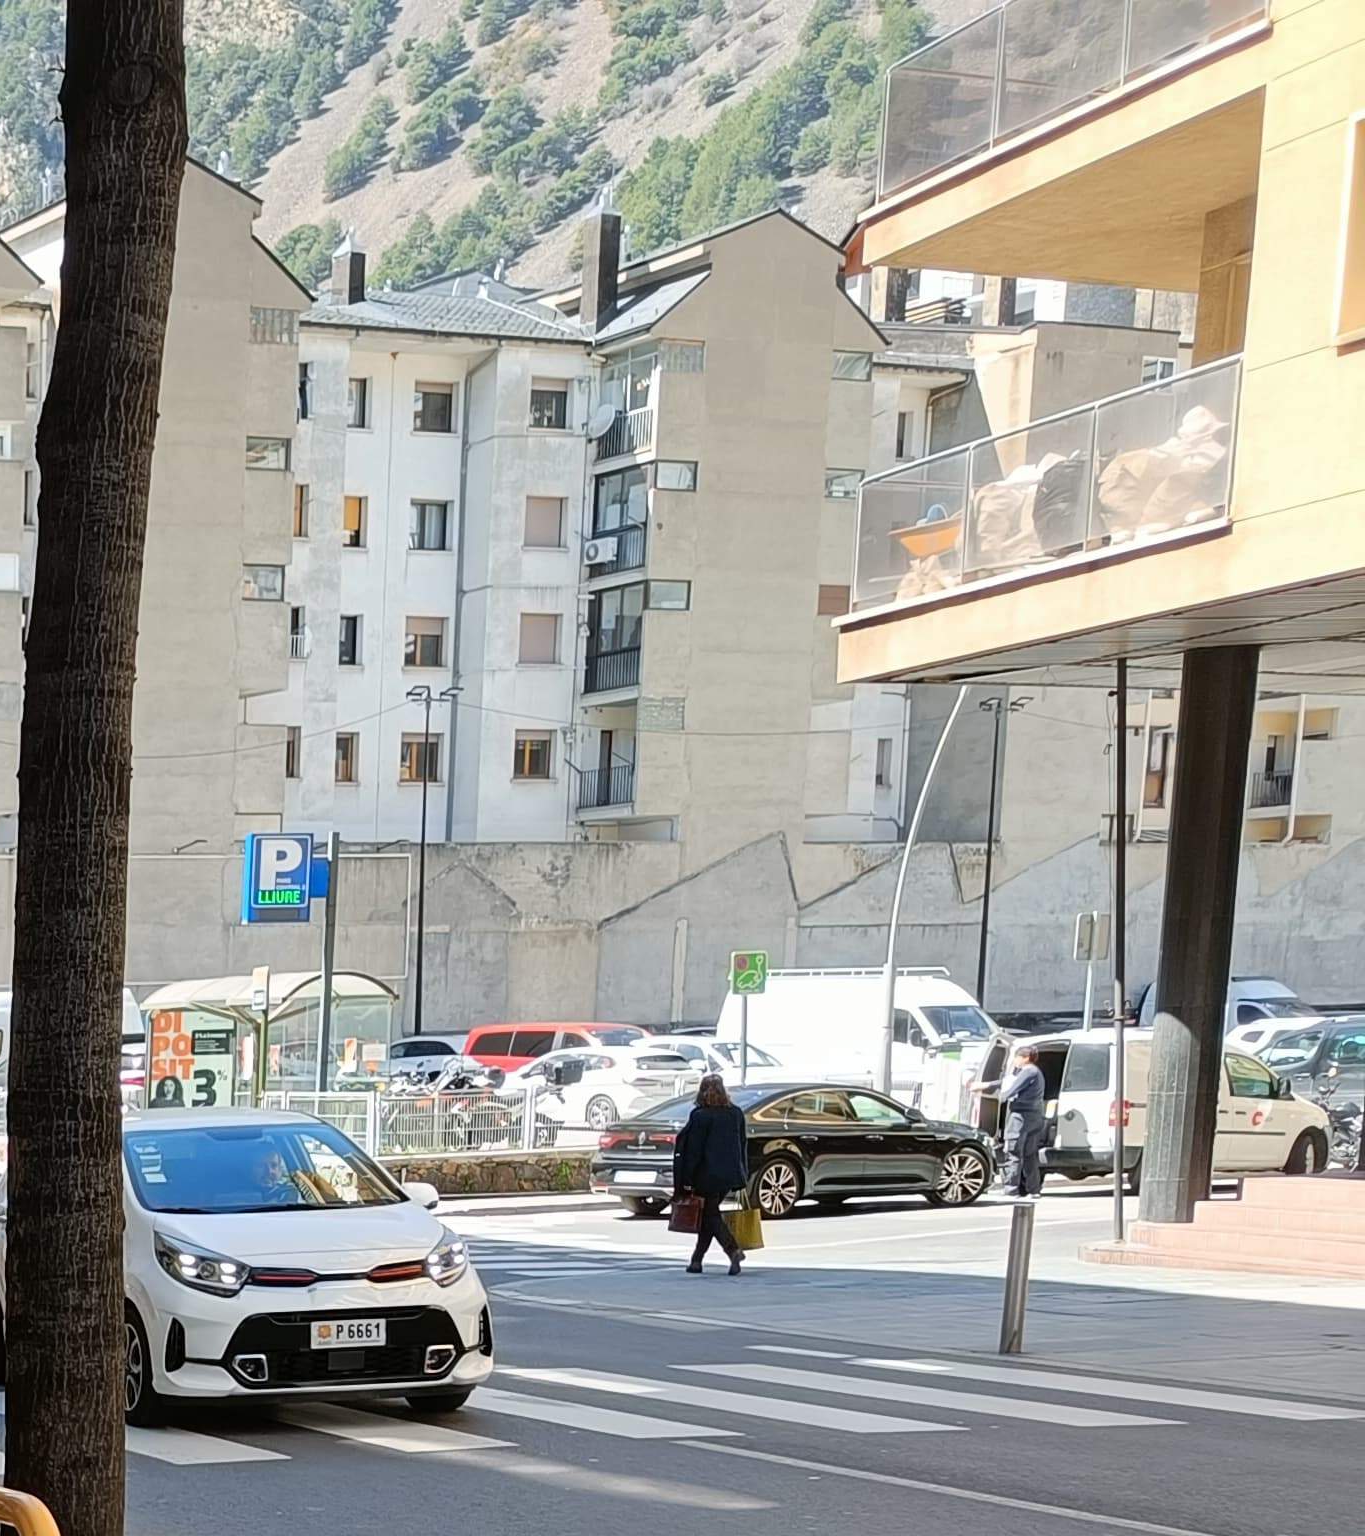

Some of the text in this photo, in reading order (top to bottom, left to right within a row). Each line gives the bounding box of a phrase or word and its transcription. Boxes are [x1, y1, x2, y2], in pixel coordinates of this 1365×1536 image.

[259, 839, 303, 890] P
[258, 890, 300, 904] LLIURE
[336, 1322, 380, 1339] P 6661
